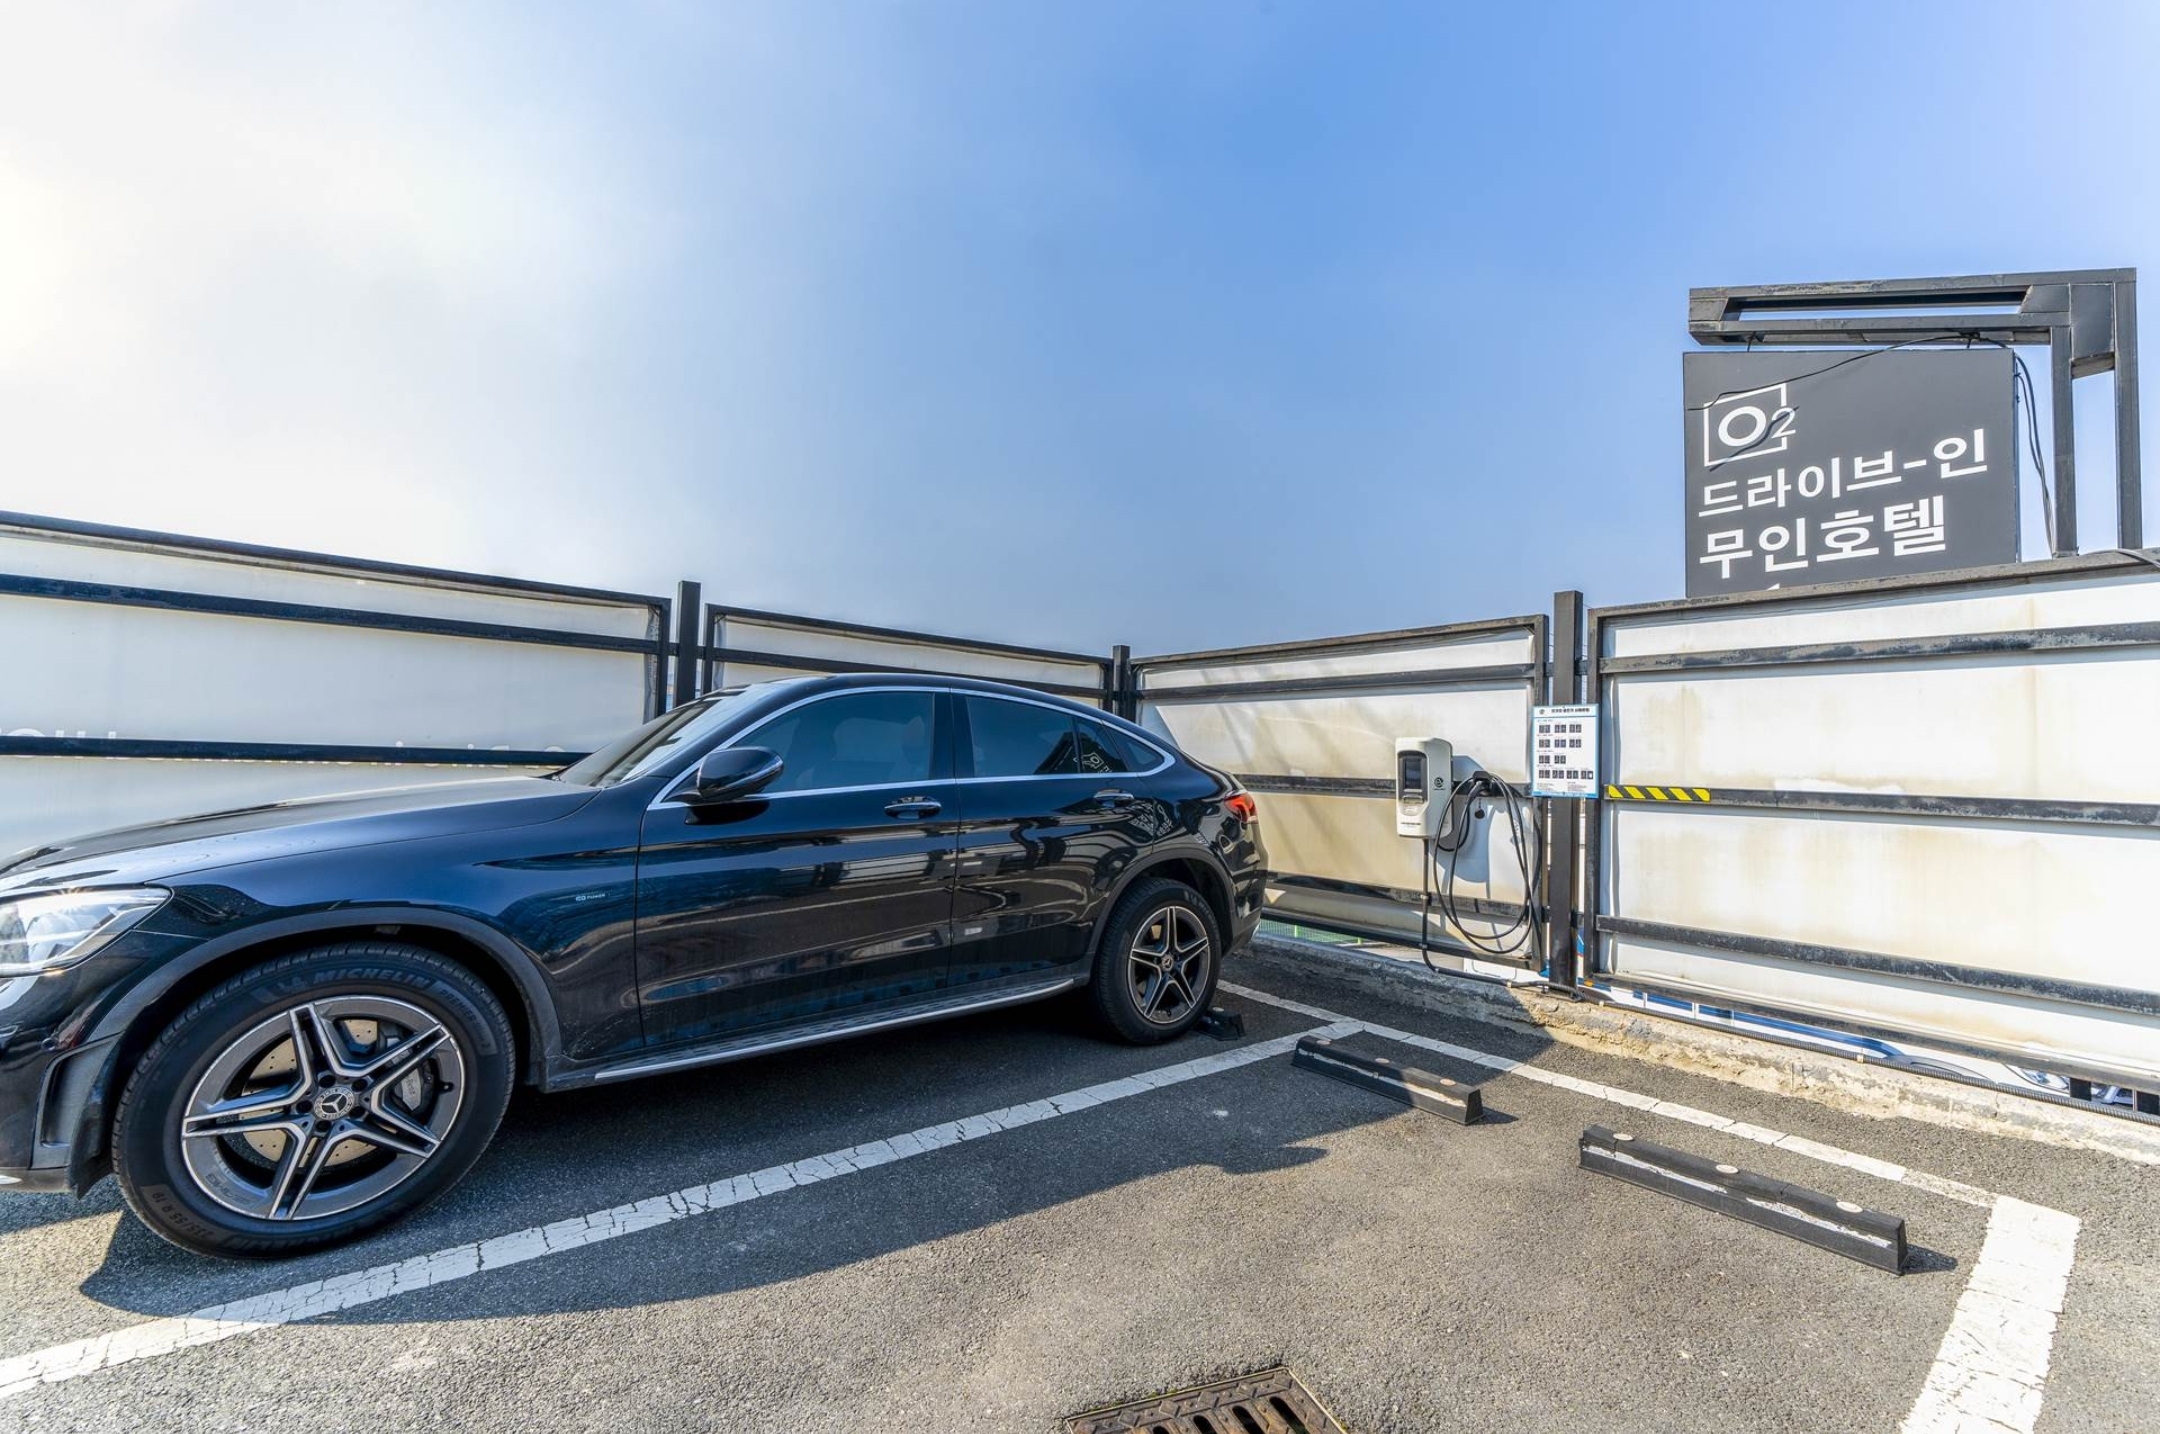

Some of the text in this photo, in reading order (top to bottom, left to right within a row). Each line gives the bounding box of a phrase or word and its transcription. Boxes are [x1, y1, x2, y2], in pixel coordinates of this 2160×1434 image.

[1699, 429, 1988, 518] 드라이브-인
[1699, 495, 1946, 579] 무인호텔
[313, 968, 431, 989] MICHELIN
